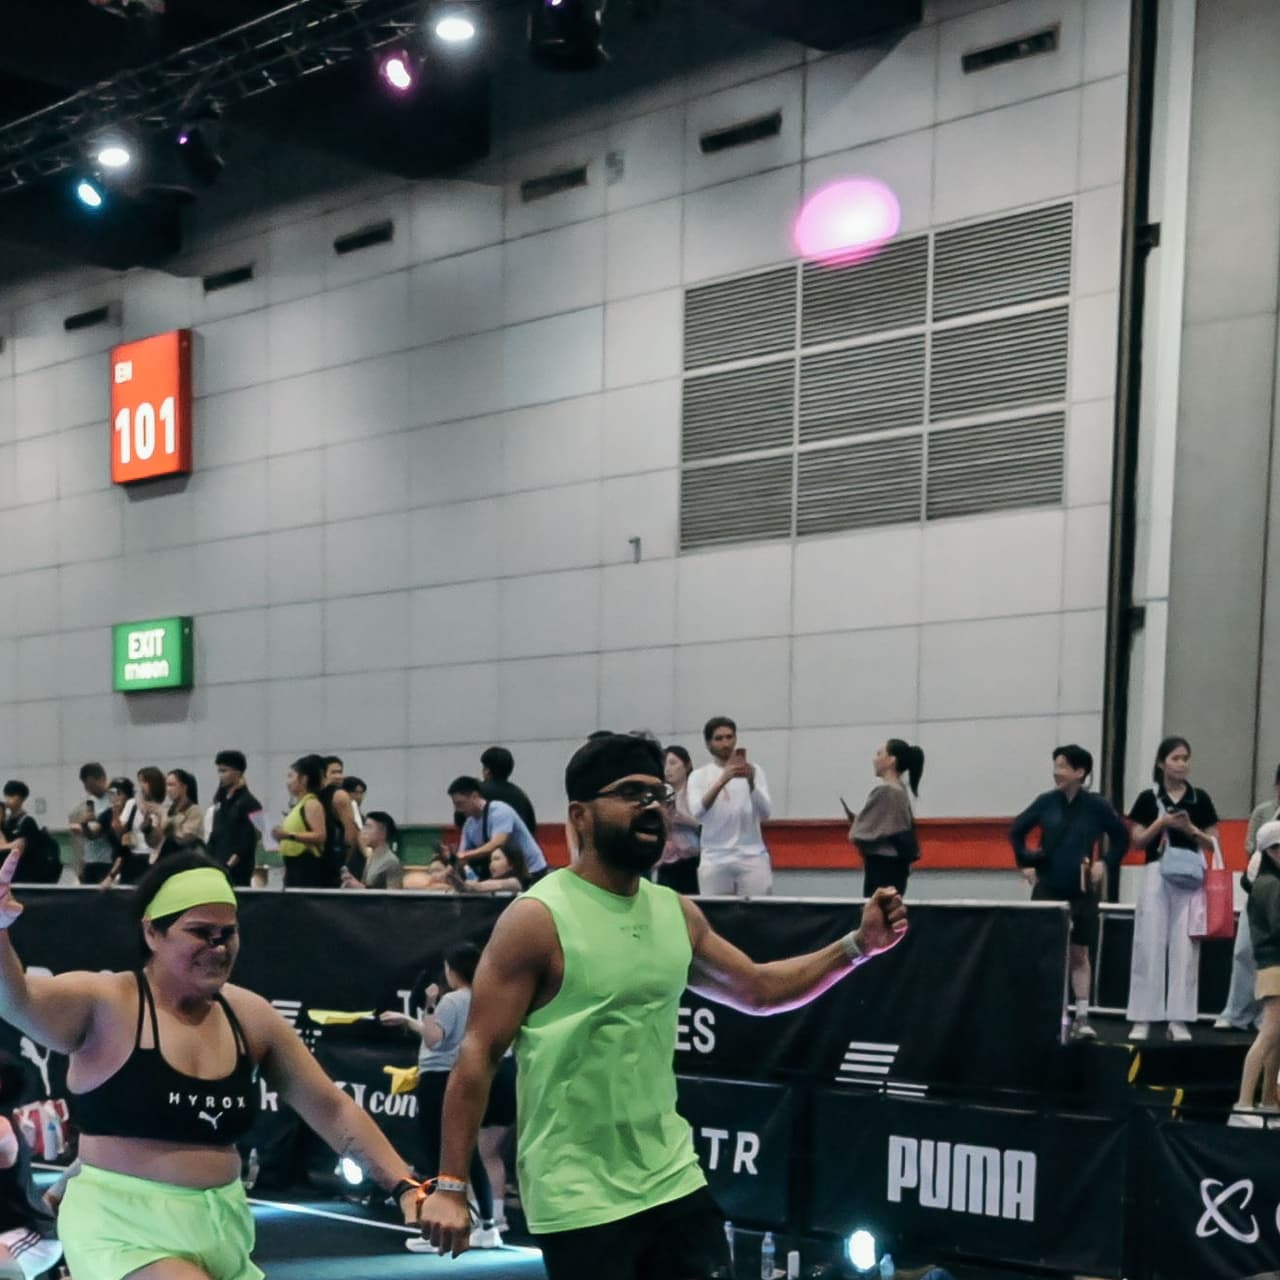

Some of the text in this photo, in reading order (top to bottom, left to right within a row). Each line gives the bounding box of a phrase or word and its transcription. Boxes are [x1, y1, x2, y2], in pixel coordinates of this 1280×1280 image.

[115, 396, 176, 464] 101
[128, 628, 166, 660] EXIT
[168, 1091, 246, 1109] HYROX
[887, 1135, 1037, 1222] PUMA
